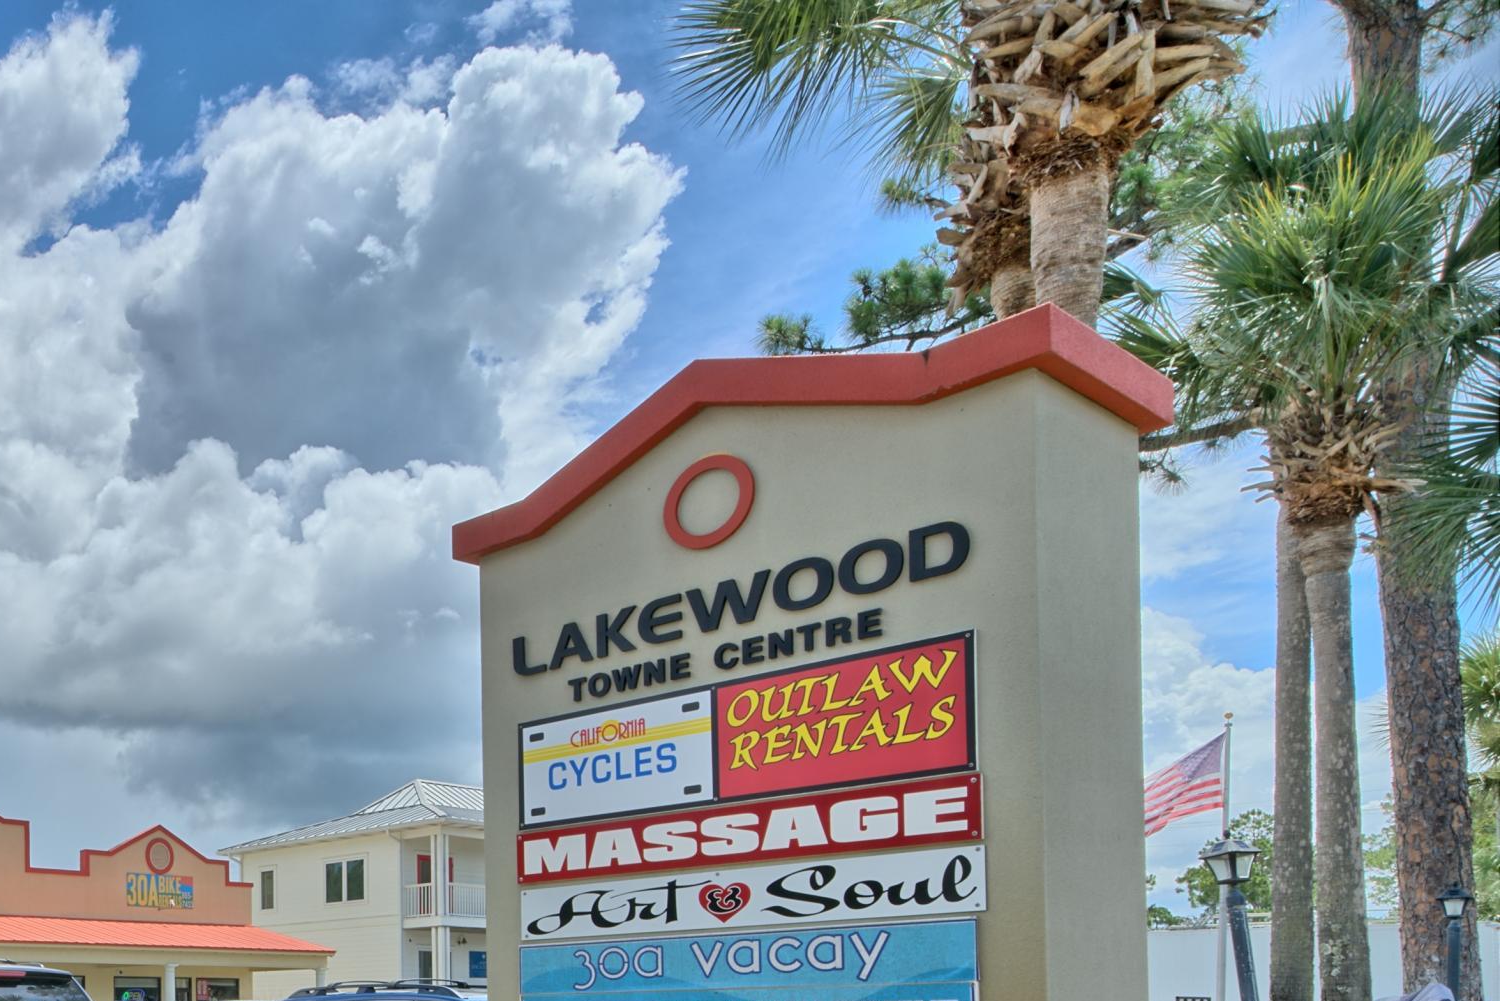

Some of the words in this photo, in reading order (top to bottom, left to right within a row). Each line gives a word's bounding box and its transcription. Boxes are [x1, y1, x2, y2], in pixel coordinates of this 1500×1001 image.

[512, 521, 970, 677] LAKEWOOD
[568, 652, 692, 702] TOWNE
[713, 608, 883, 671] CENTRE
[726, 649, 959, 728] OUTLAW
[548, 743, 678, 791] CYCLES
[570, 717, 646, 749] CALIFORNIA
[729, 695, 958, 771] RENTALS
[524, 786, 969, 876] MASSAGE
[127, 874, 159, 907] 30A
[158, 876, 181, 894] BIKE
[526, 879, 713, 936] Art
[761, 854, 979, 918] Soul
[572, 943, 664, 991] 30a
[690, 930, 891, 982] vacay
